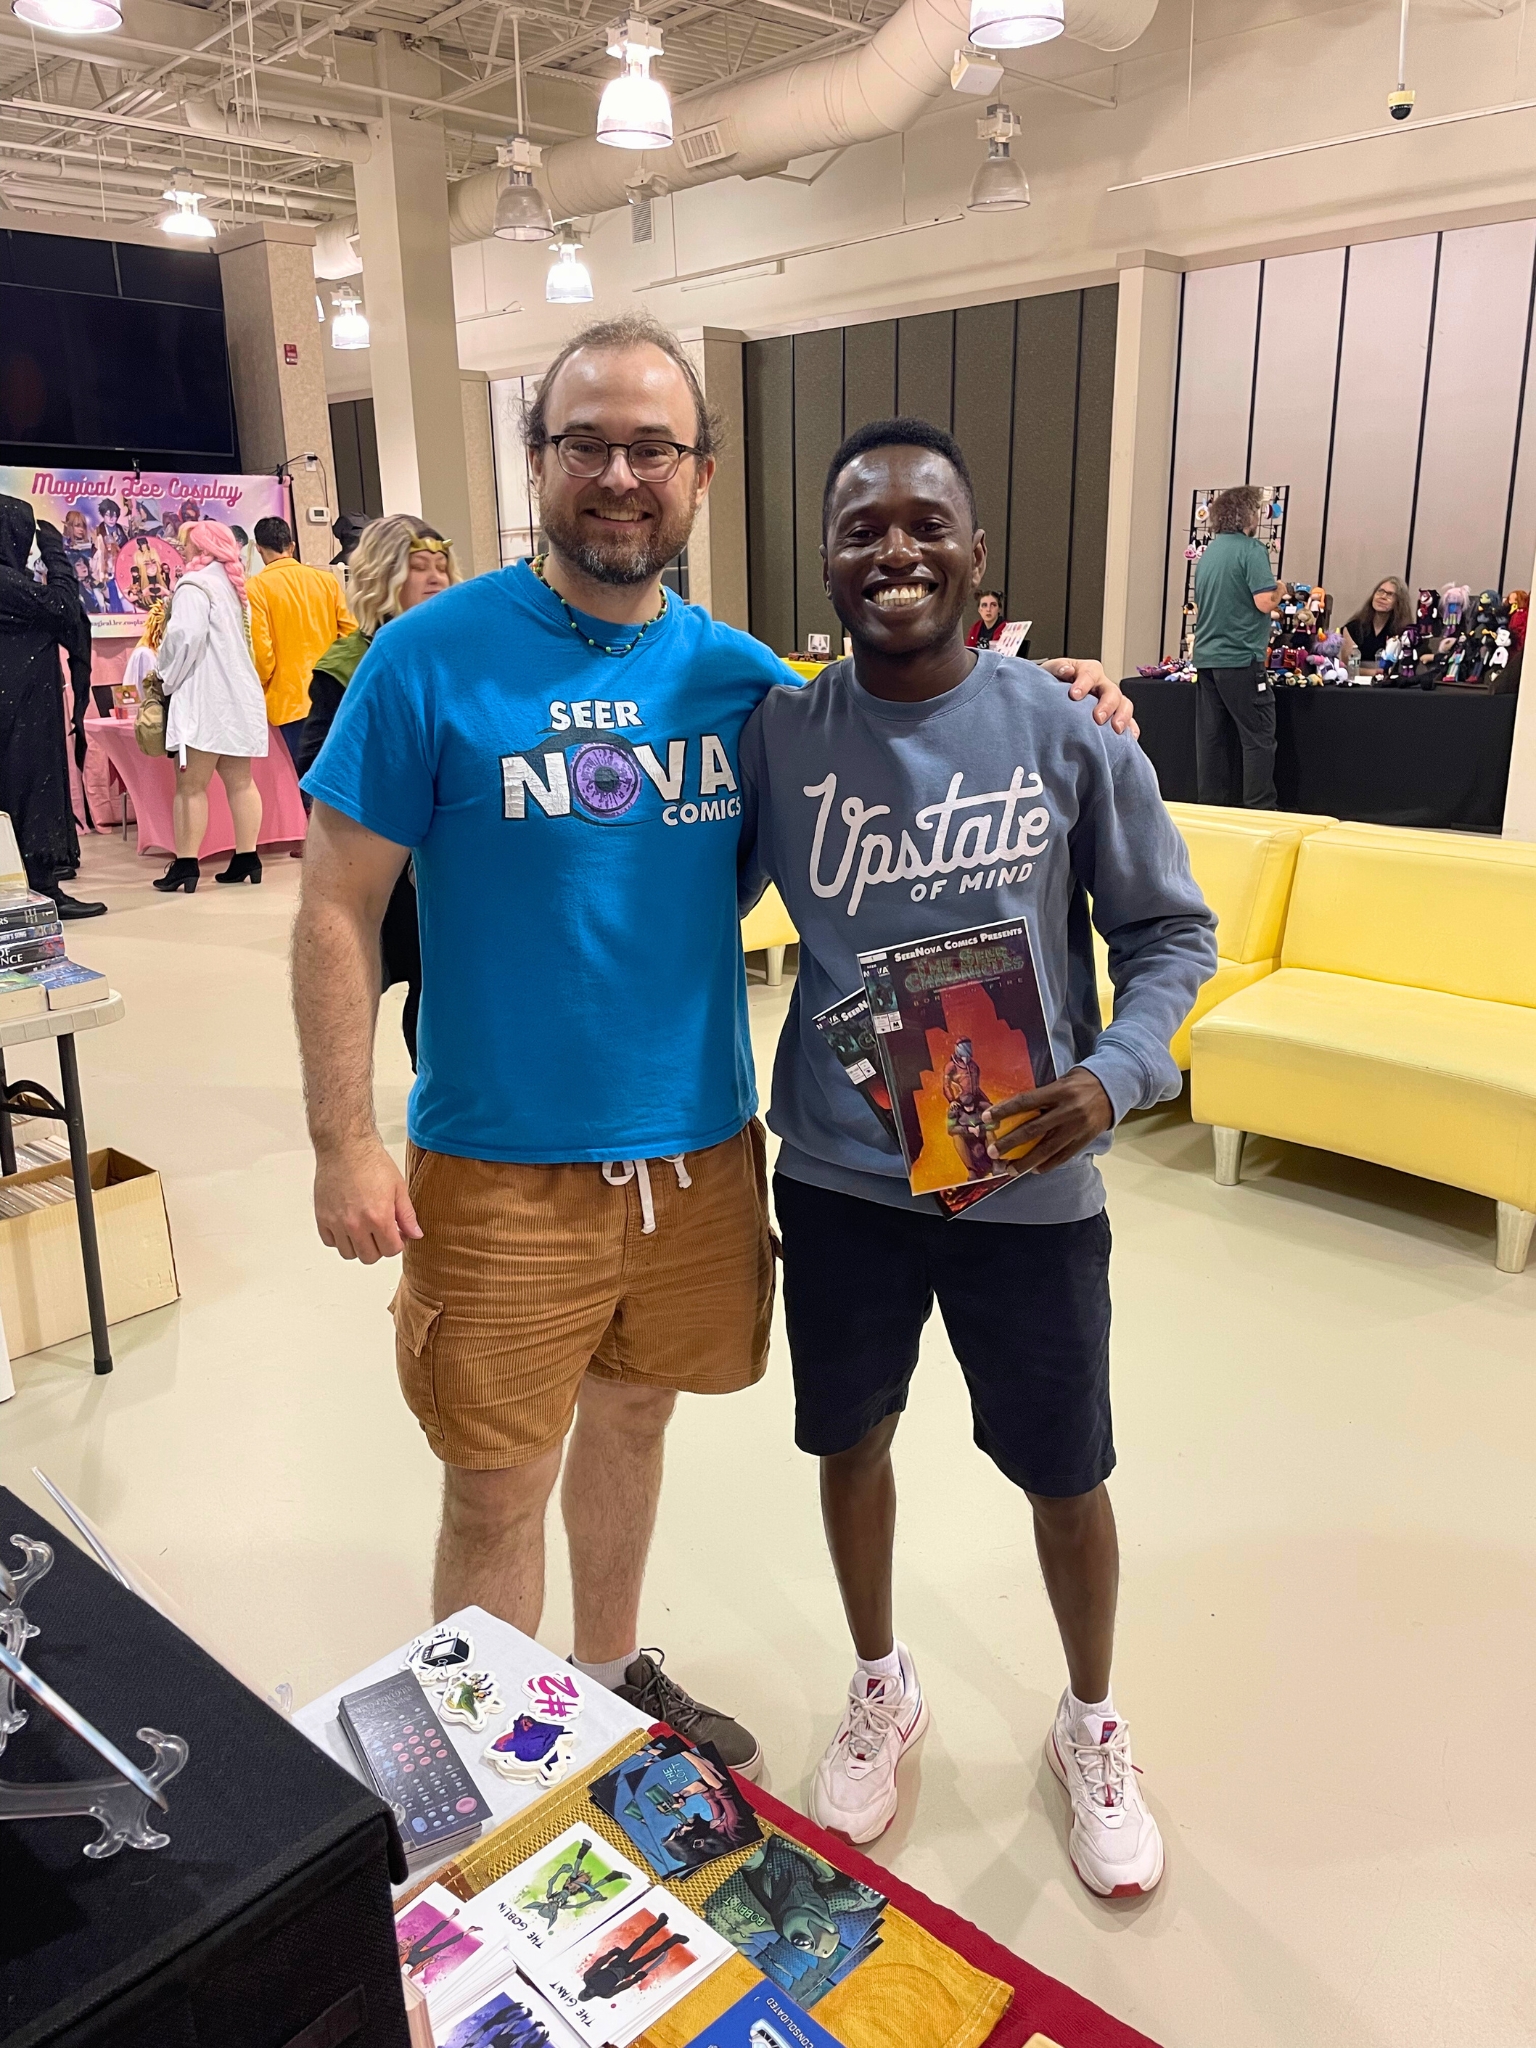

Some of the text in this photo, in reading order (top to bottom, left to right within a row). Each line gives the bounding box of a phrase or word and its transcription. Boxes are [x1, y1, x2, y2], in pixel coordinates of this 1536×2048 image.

[31, 473, 243, 507] Magical Lee Cosplay
[549, 700, 643, 731] SEER
[500, 733, 738, 820] NOVA
[662, 796, 742, 826] COMICS
[802, 765, 1050, 916] Upstate
[910, 864, 1034, 902] OF MIND
[662, 1766, 678, 1785] THE
[671, 1762, 689, 1785] LOFT
[497, 1902, 546, 1949] THE GOBLIN
[548, 1980, 596, 2028] THE GIANT
[766, 1997, 815, 2048] CONSOLIDATED
